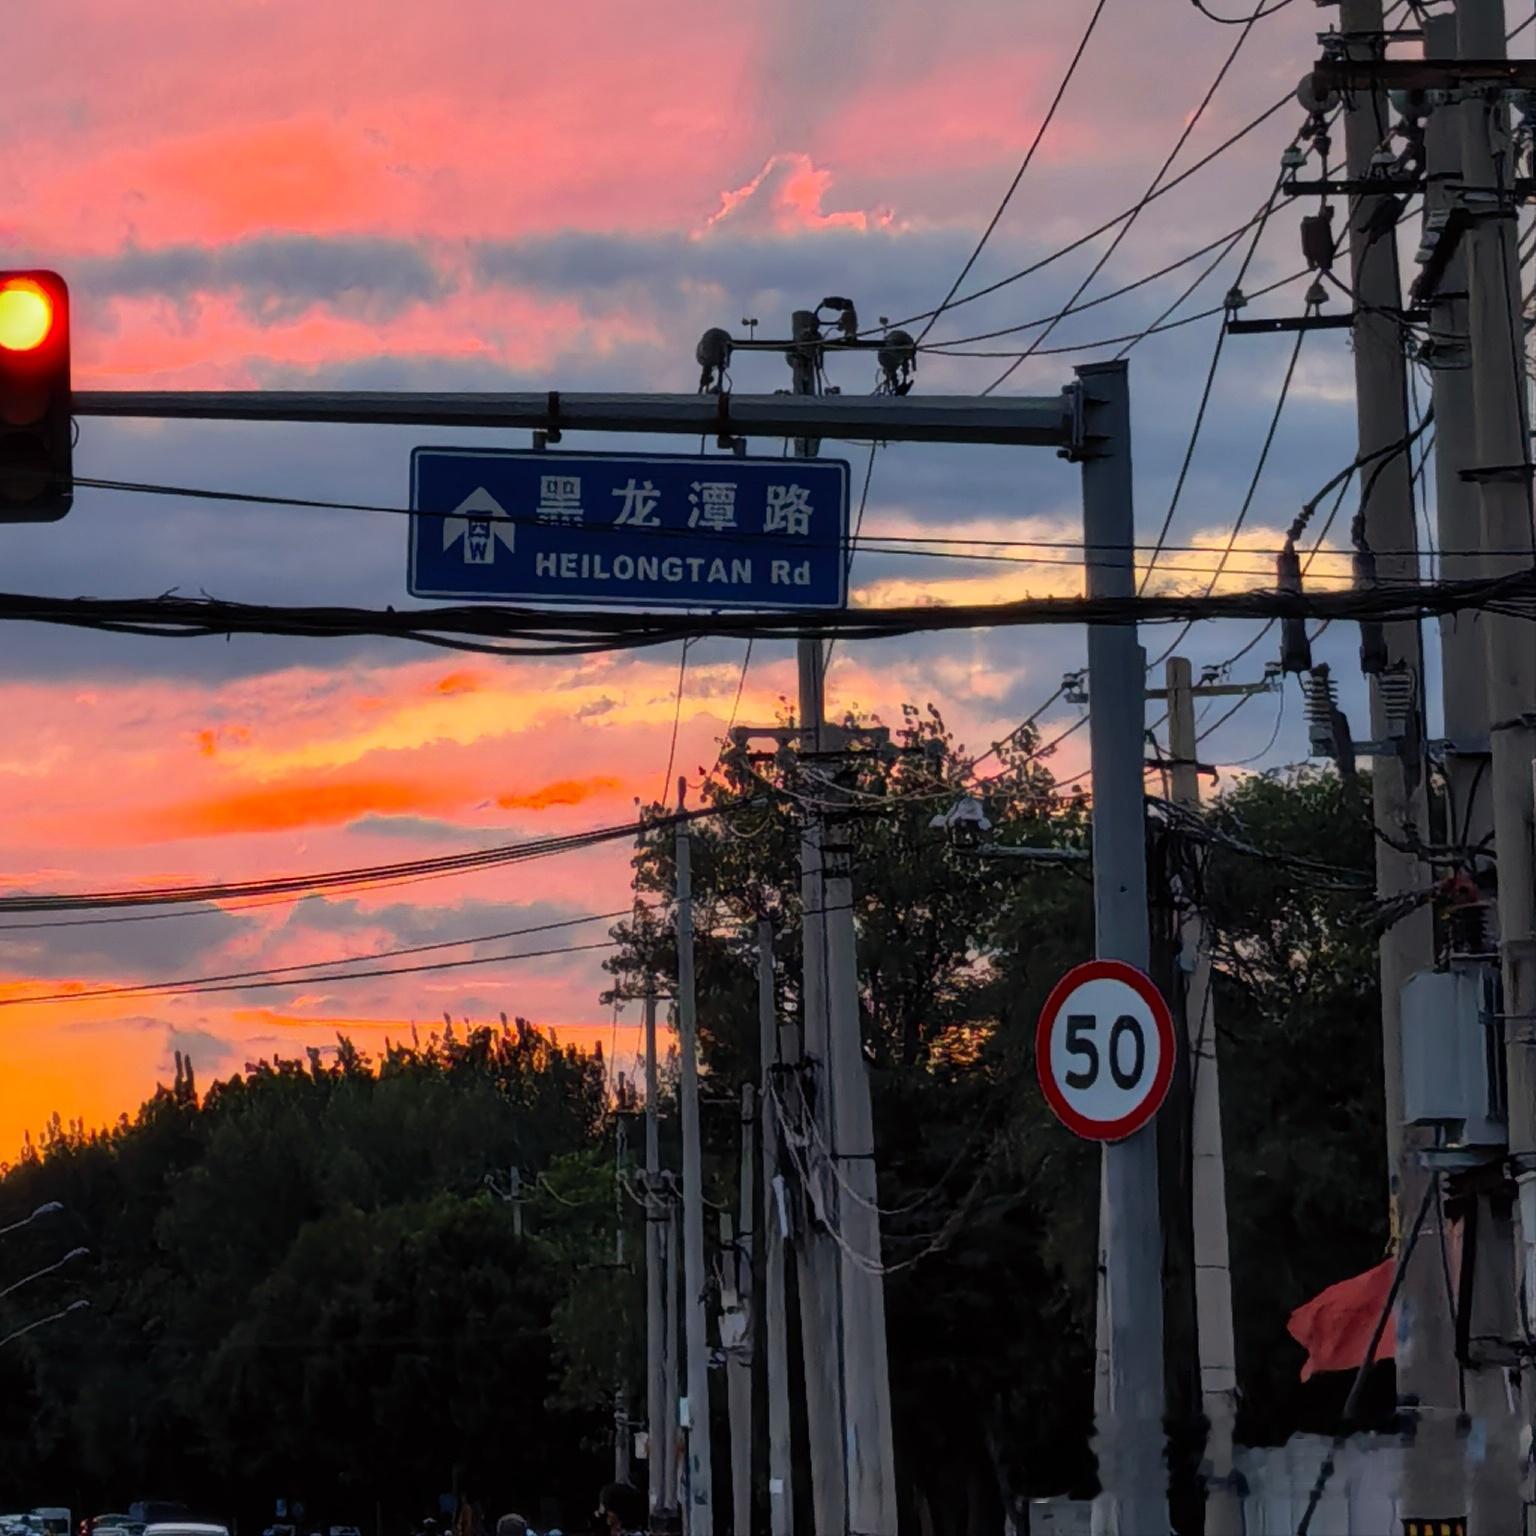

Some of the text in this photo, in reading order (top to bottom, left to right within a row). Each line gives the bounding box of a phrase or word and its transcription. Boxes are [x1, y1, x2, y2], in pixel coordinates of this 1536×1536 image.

[536, 475, 814, 536] 黑龙潭路
[468, 537, 489, 561] W
[536, 552, 811, 586] HEILONGTAN Rd
[1066, 1014, 1145, 1090] 50
